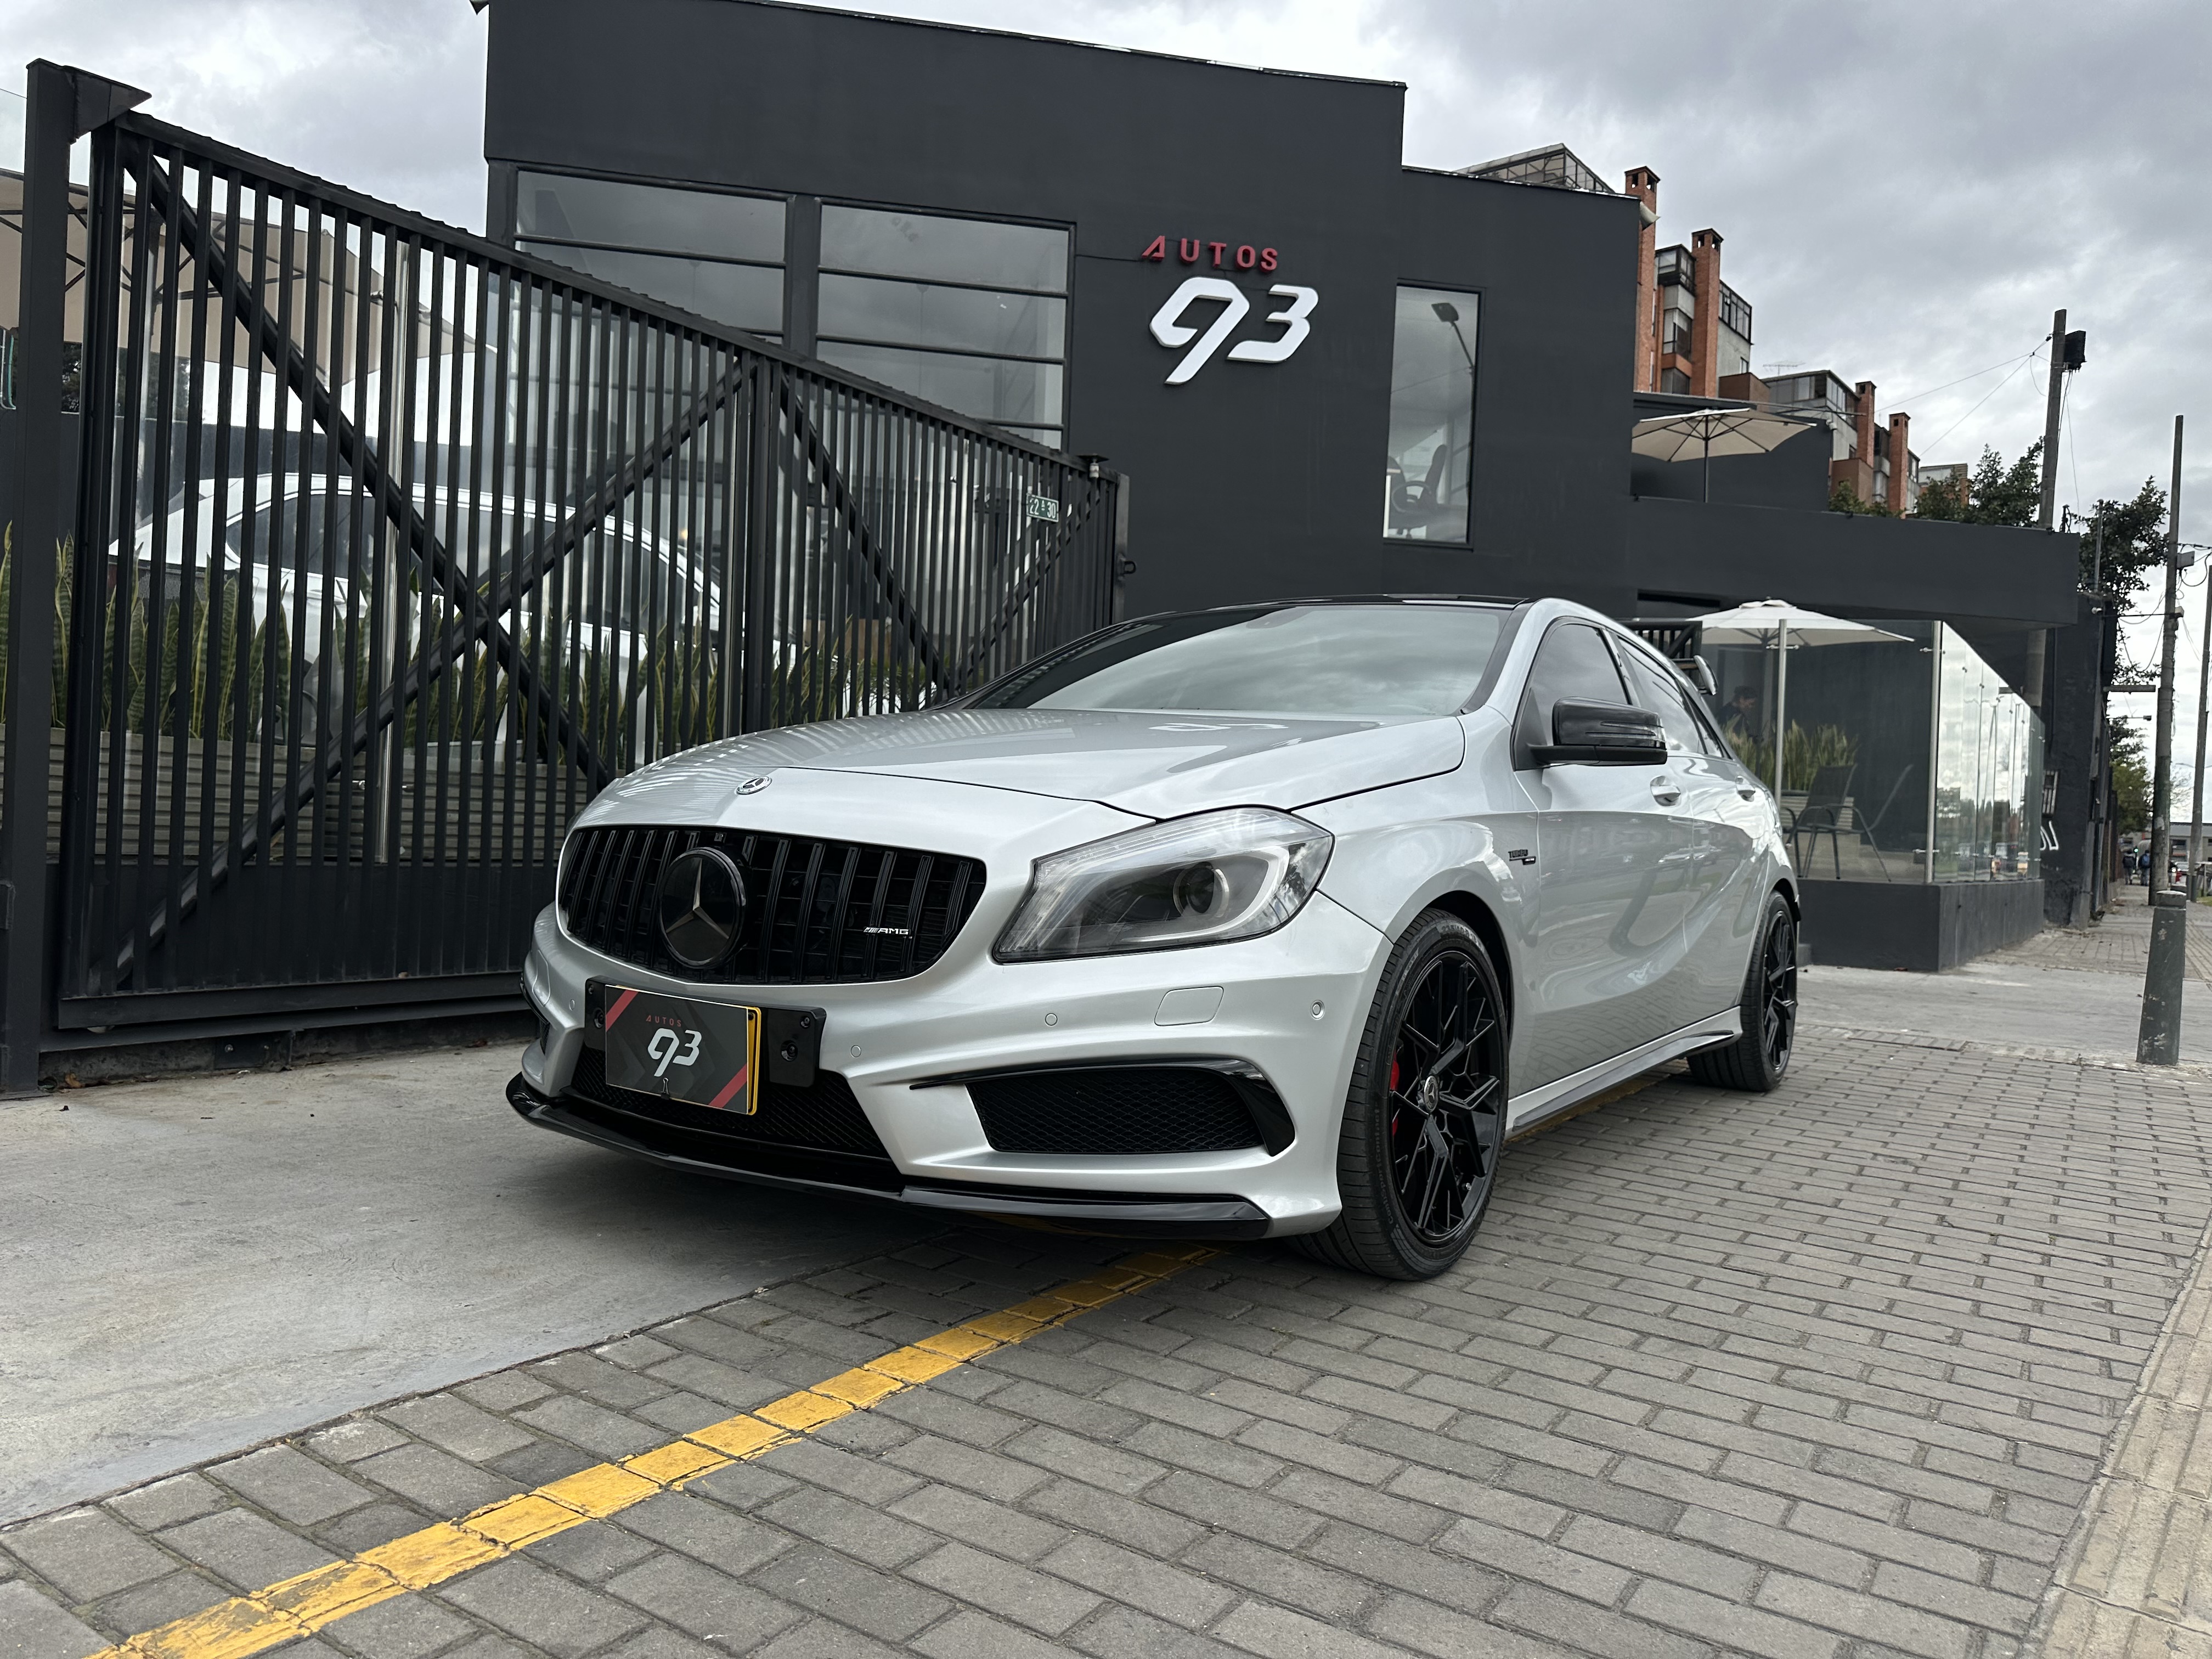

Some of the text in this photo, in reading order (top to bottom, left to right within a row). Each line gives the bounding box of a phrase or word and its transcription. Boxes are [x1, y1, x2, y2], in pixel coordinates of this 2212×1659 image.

[1142, 235, 1278, 272] AUTOS
[1149, 276, 1319, 385] 93
[646, 1015, 681, 1027] AUTOS
[647, 1028, 702, 1077] 93
